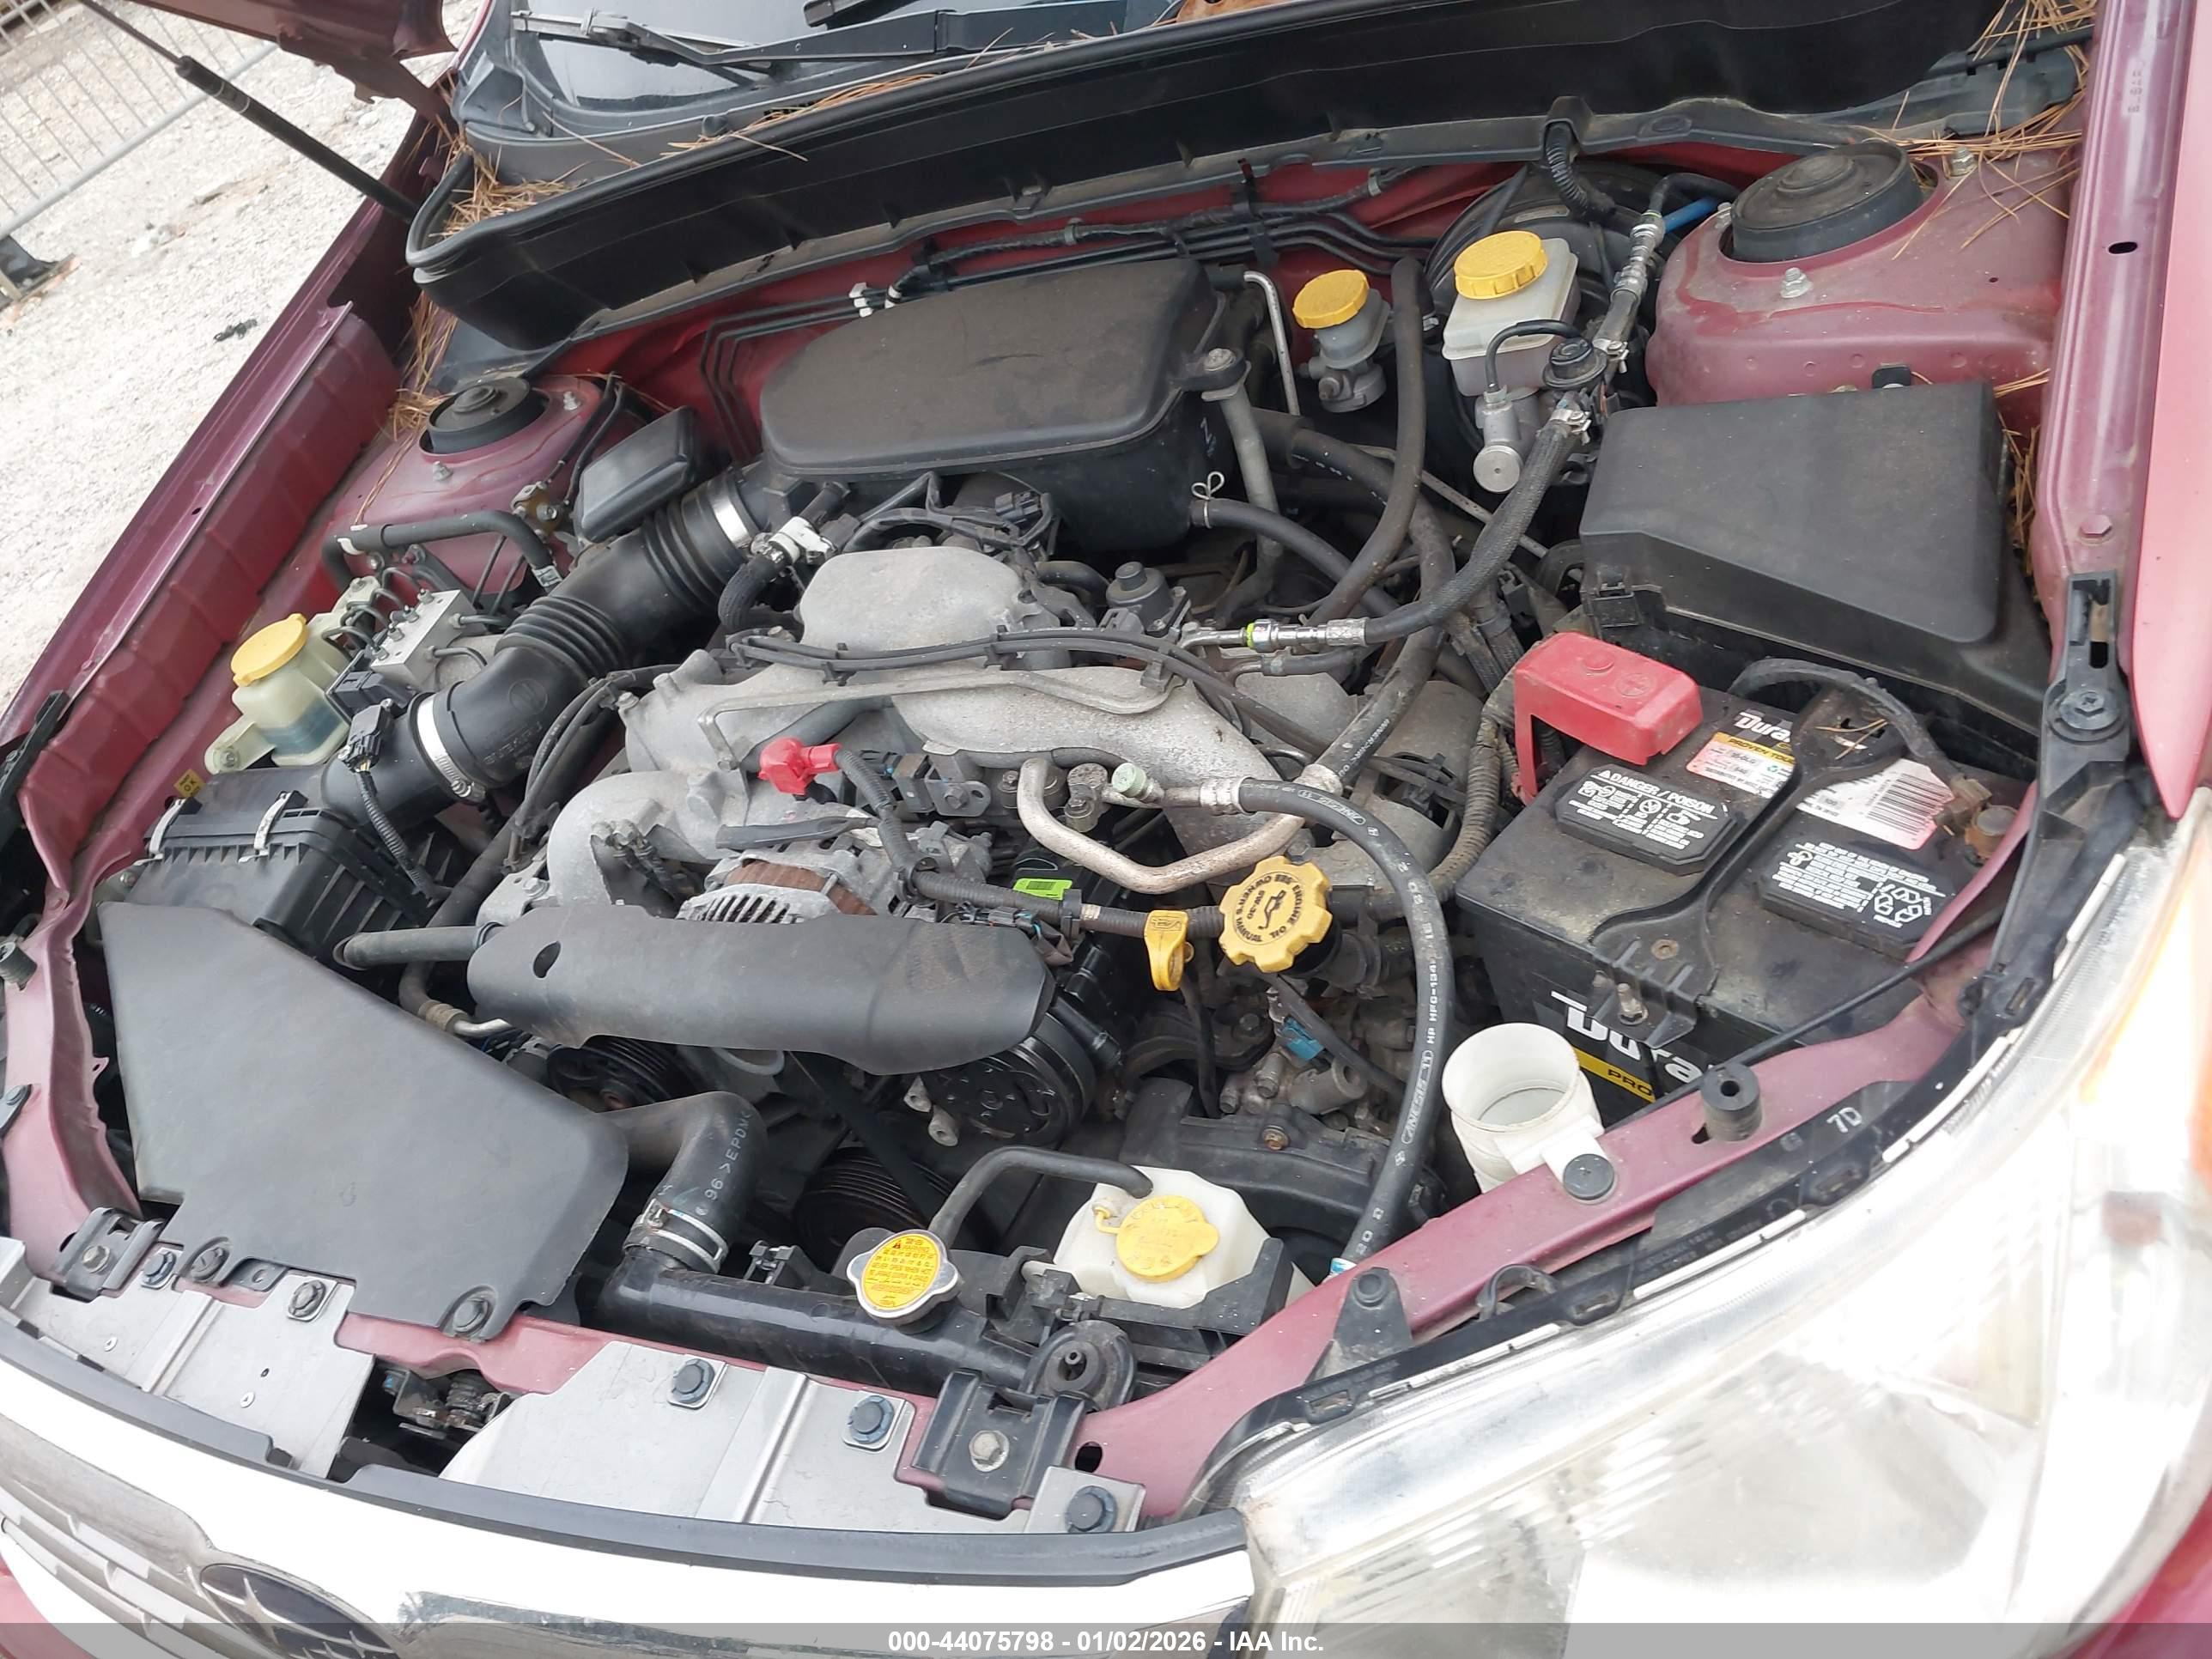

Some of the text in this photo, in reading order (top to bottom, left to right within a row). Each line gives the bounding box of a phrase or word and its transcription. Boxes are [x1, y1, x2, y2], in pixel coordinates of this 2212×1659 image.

[1610, 773, 1661, 797] DANGER
[1668, 792, 1716, 815] POISON
[1247, 890, 1266, 921] 5W-30
[1288, 884, 1304, 925] ENGINE
[1236, 918, 1263, 942] MANUAL
[1607, 1068, 1653, 1097] PRO
